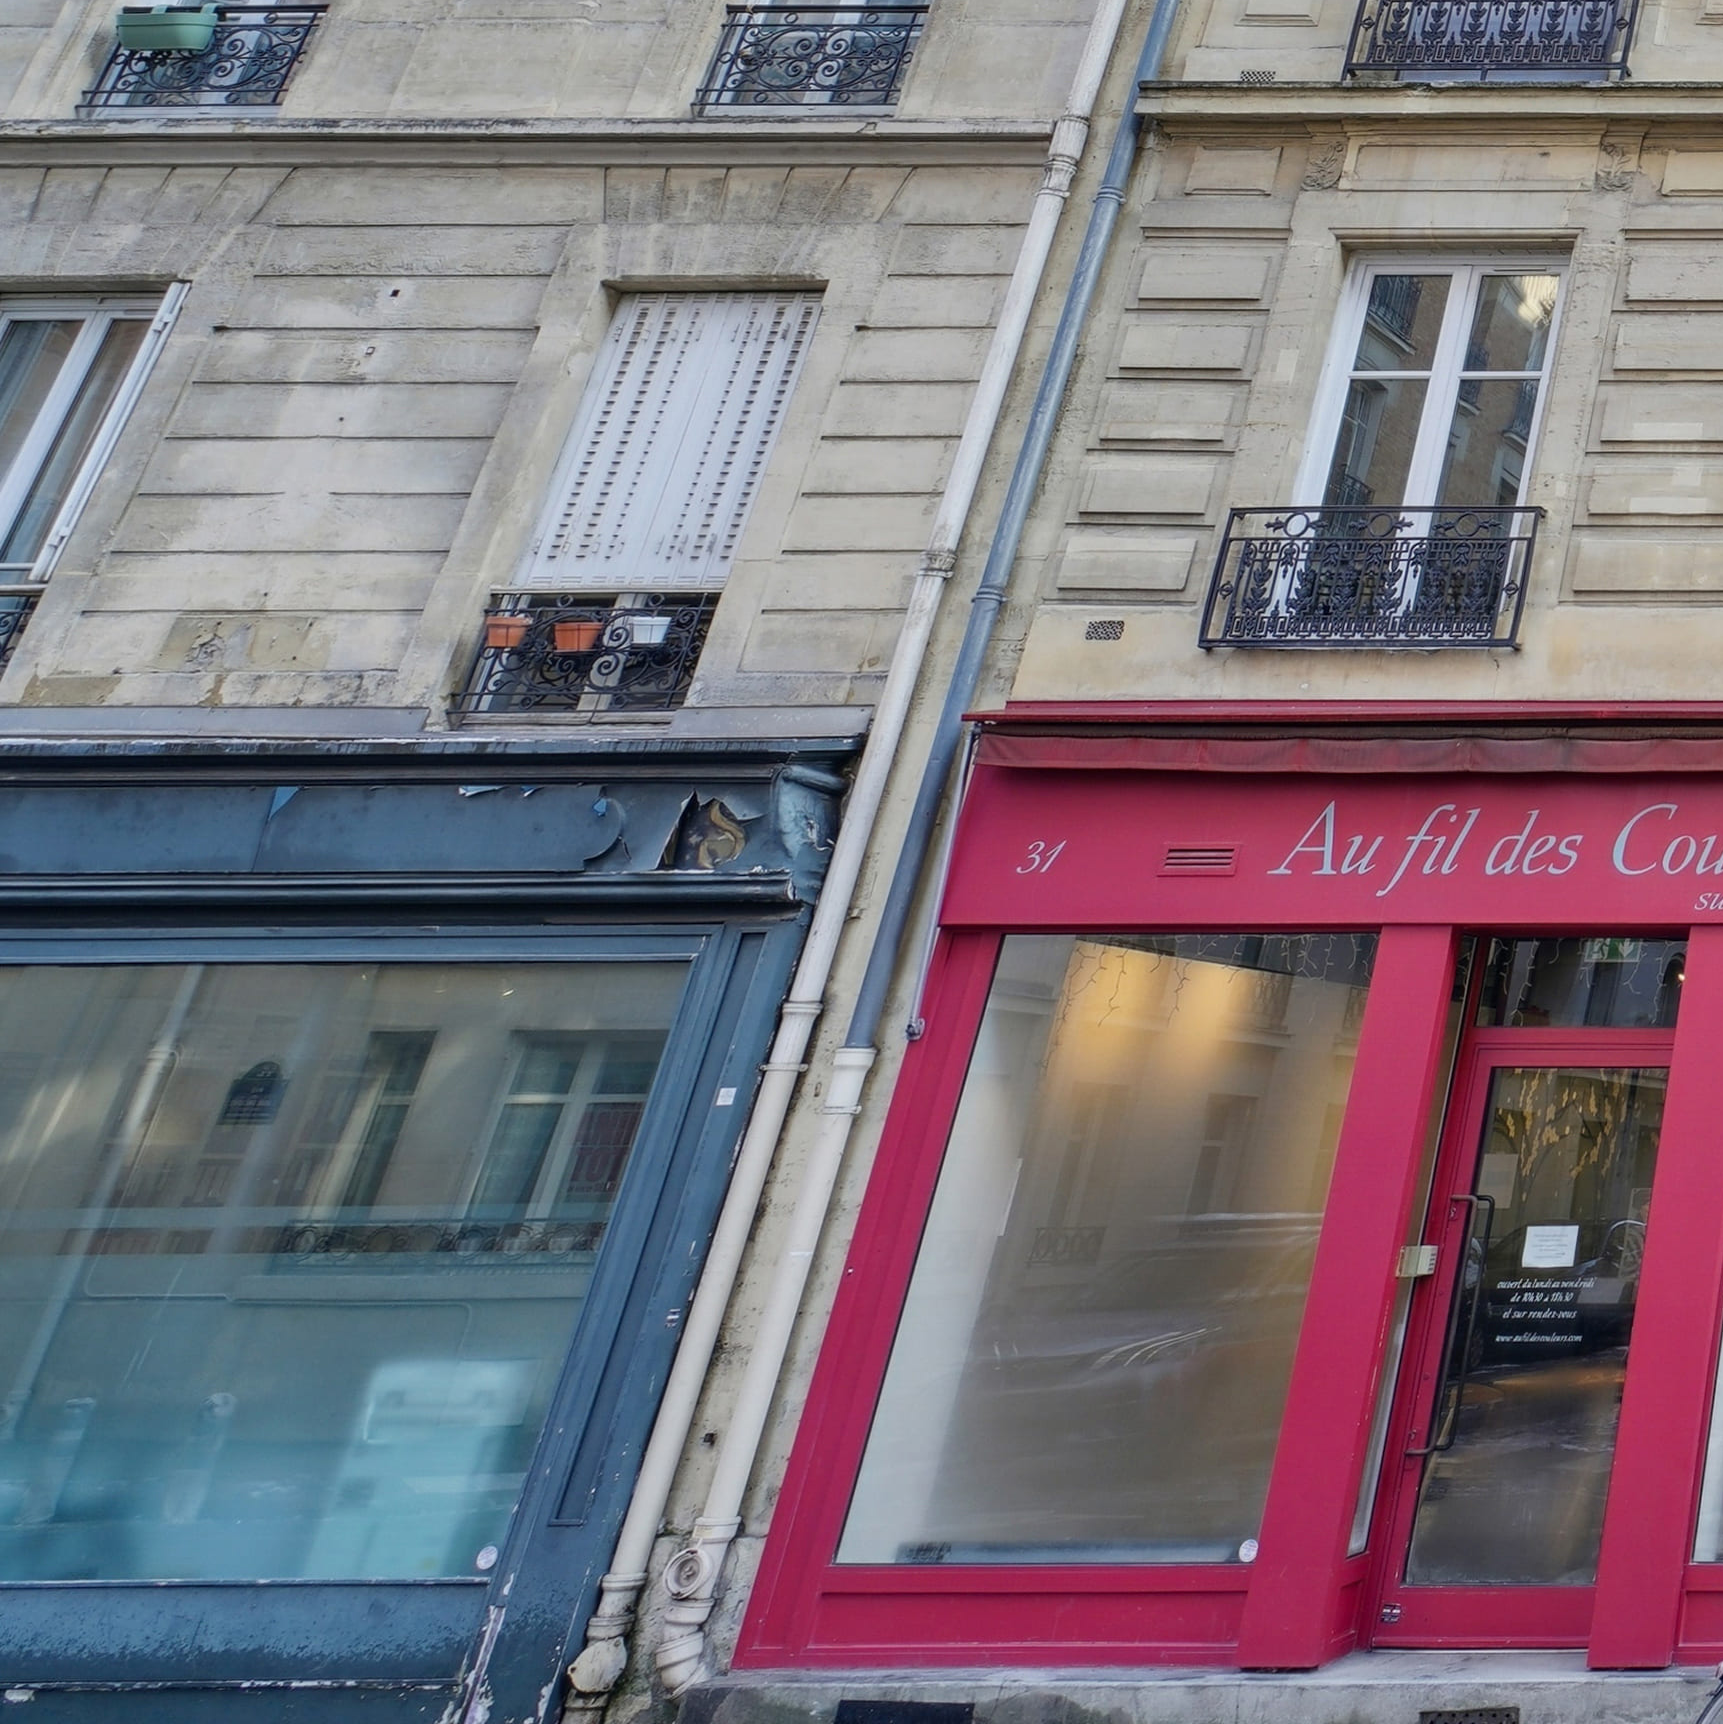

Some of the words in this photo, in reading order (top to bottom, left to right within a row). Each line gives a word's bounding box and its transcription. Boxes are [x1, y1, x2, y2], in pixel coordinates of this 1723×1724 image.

[1266, 801, 1384, 875] Au
[1375, 804, 1481, 897] fil
[1484, 809, 1584, 876] des
[1016, 840, 1067, 874] 31
[1497, 1278, 1522, 1290] ouvert
[1534, 1277, 1552, 1289] lundi
[1560, 1276, 1597, 1289] vendredi
[1510, 1292, 1521, 1303] de
[1502, 1308, 1512, 1319] et
[1512, 1309, 1528, 1319] sur
[1528, 1307, 1578, 1320] rendez-vous
